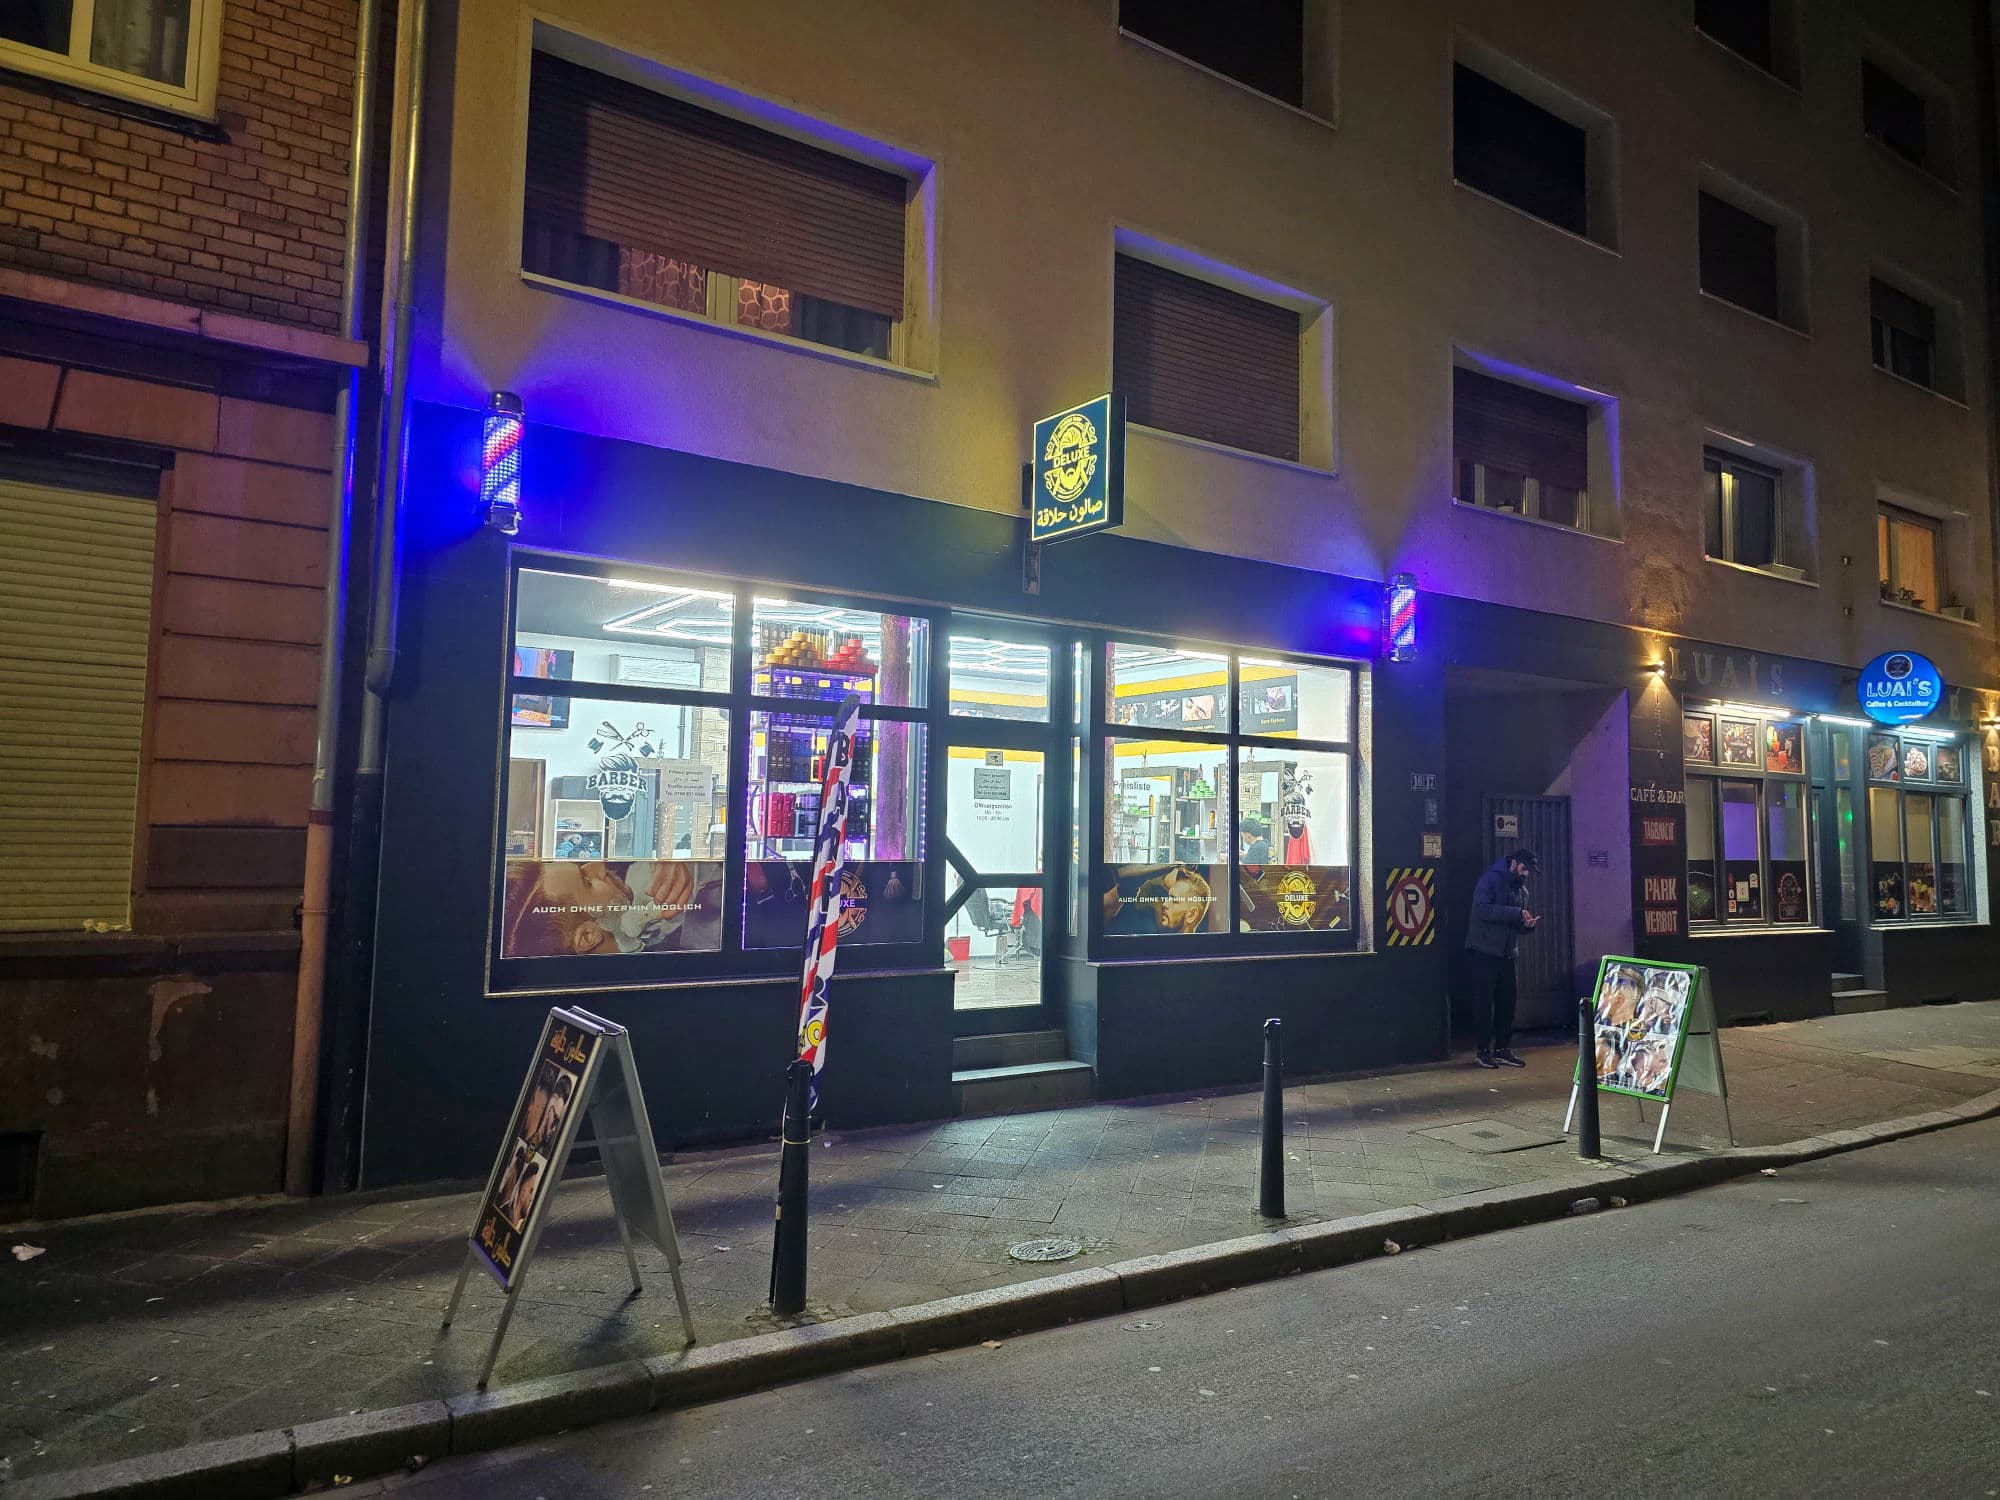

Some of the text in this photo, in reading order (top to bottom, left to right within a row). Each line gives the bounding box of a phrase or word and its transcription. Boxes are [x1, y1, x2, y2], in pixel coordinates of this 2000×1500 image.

[1054, 446, 1090, 468] DELUXE
[1037, 498, 1103, 527] صالون حلاقة
[585, 772, 648, 792] BARBER
[1631, 783, 1685, 804] CAFÉ & BAR
[1280, 804, 1312, 819] BARBER
[1284, 893, 1309, 902] DELUXE
[1645, 878, 1677, 901] PARK
[532, 902, 702, 914] AUCH OHNE TERMIN MÖGLICH
[1644, 910, 1678, 933] VERBOT
